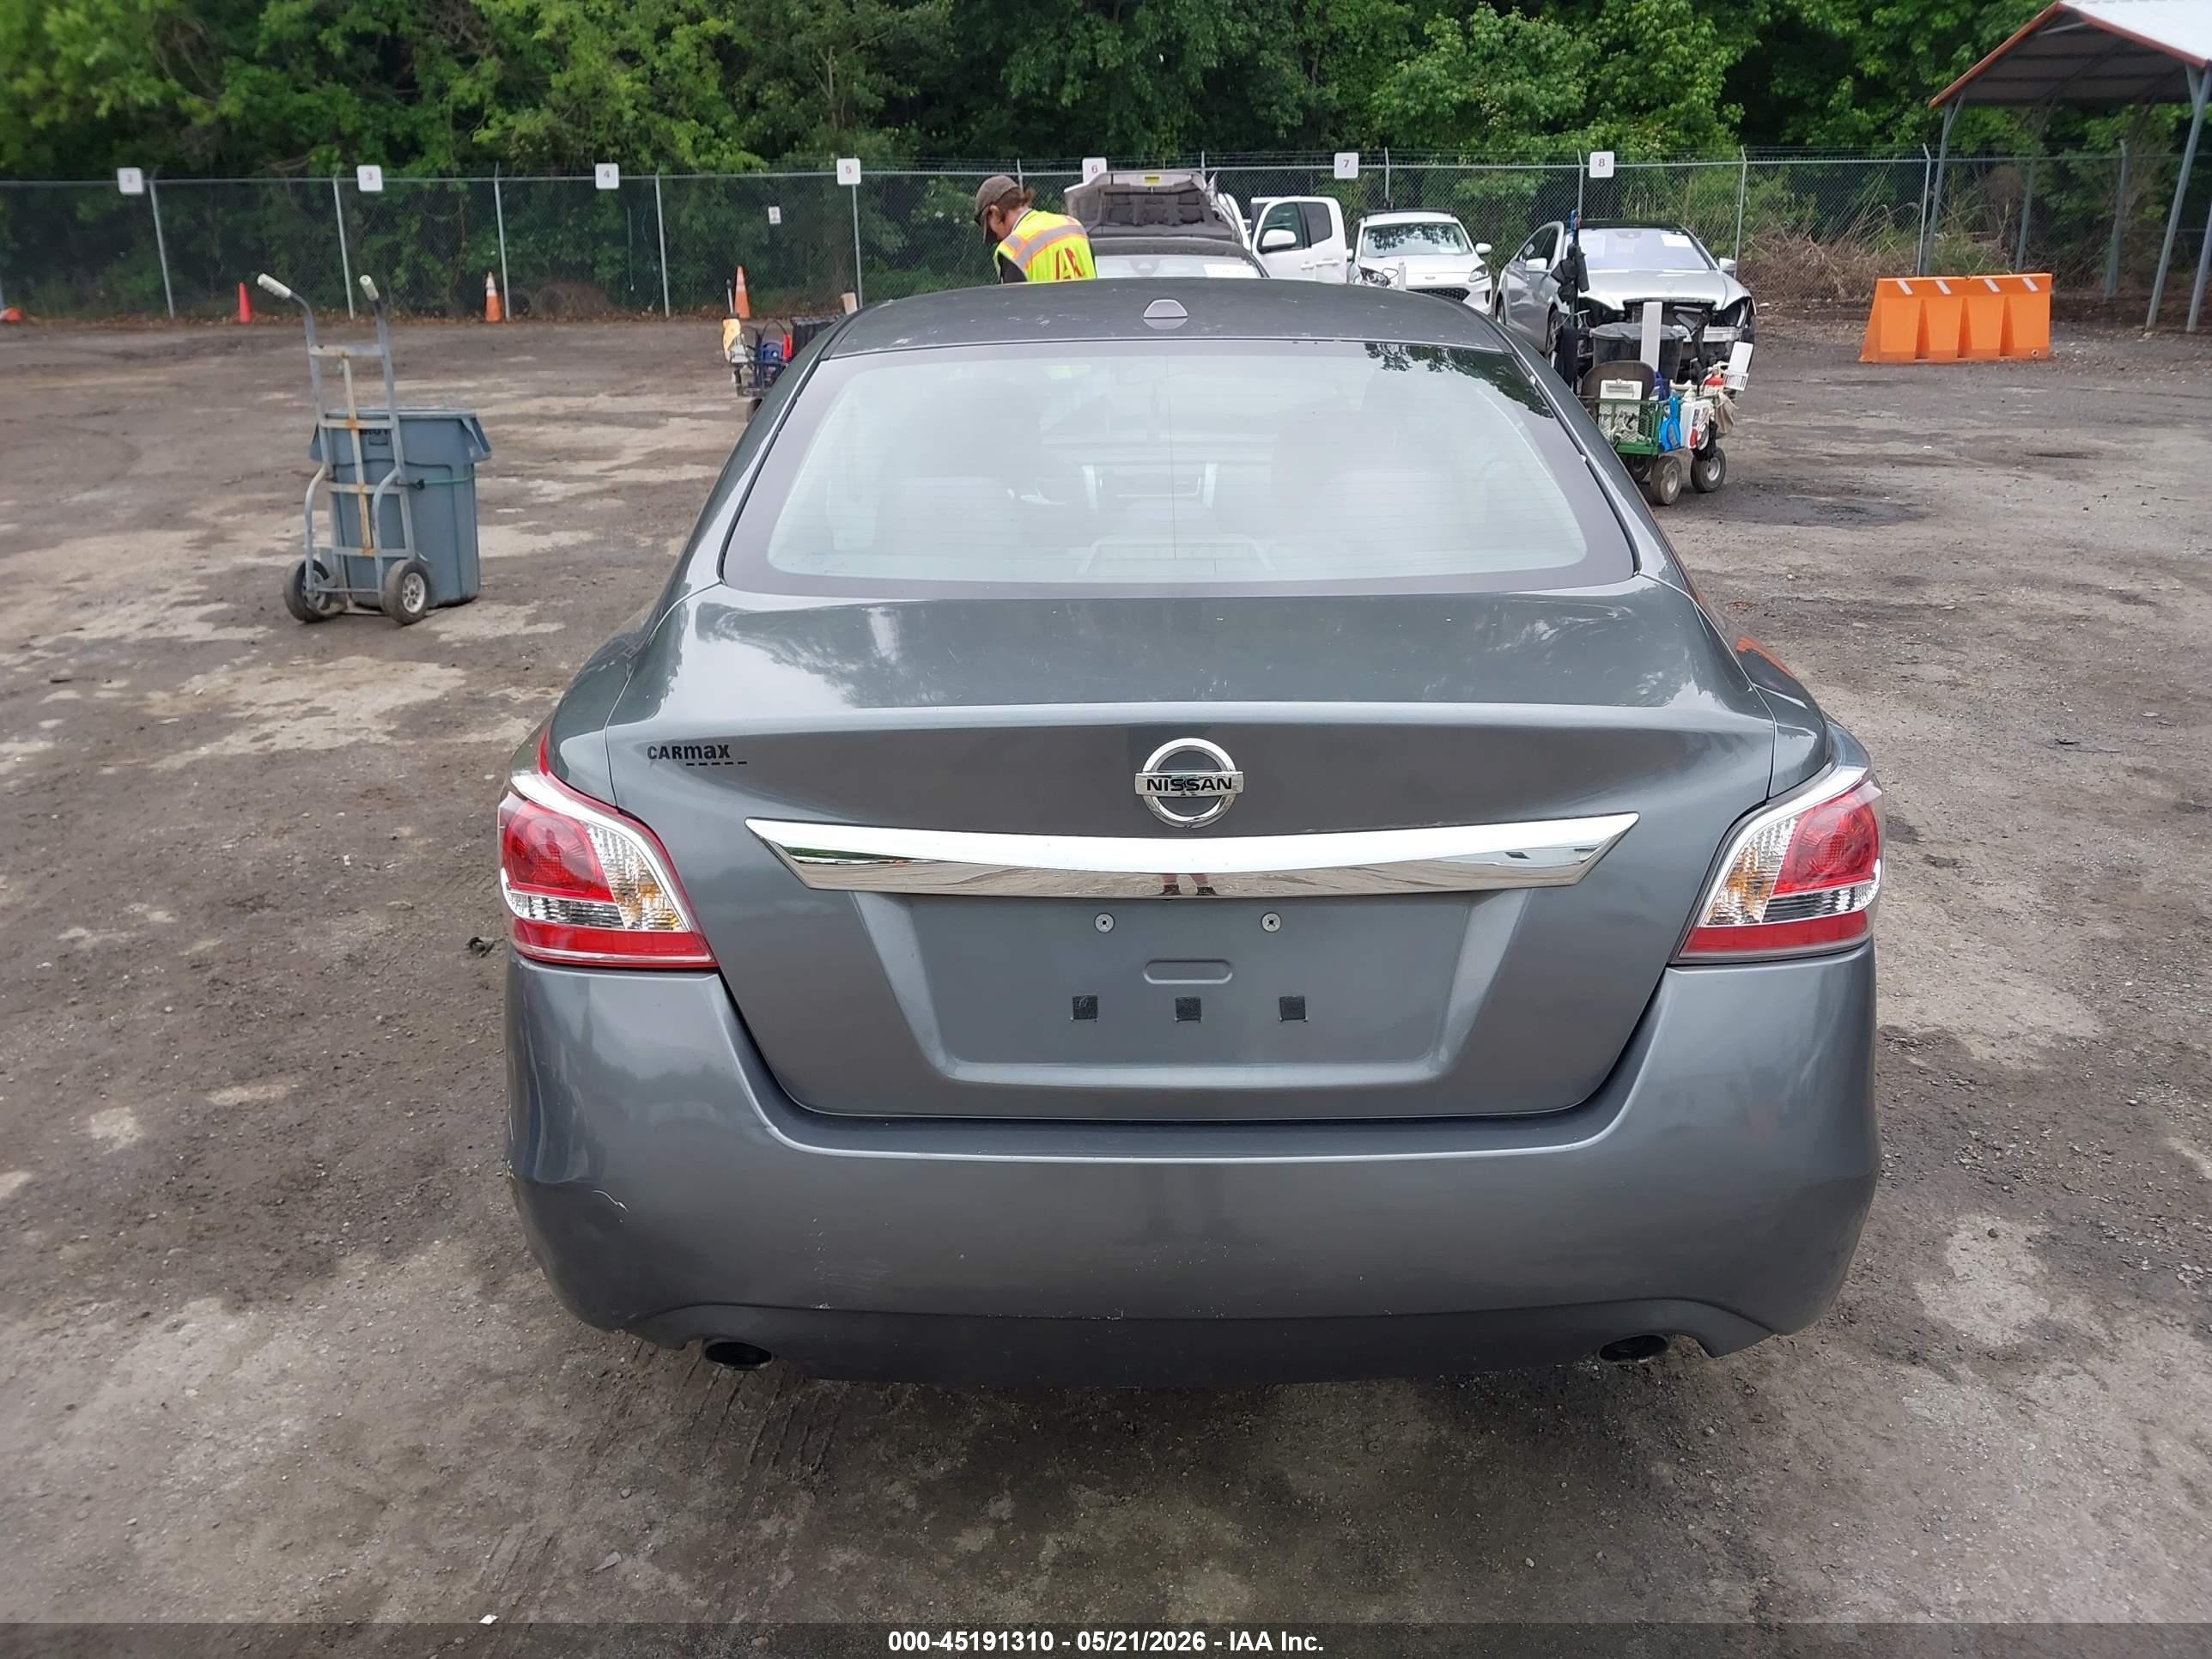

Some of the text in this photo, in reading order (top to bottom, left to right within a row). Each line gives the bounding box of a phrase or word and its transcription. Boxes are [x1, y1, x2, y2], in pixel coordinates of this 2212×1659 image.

[1342, 159, 1350, 168] 7
[1597, 158, 1606, 167] 8
[845, 165, 853, 174] 5
[1091, 164, 1098, 173] 6
[1146, 778, 1232, 791] NISSAN
